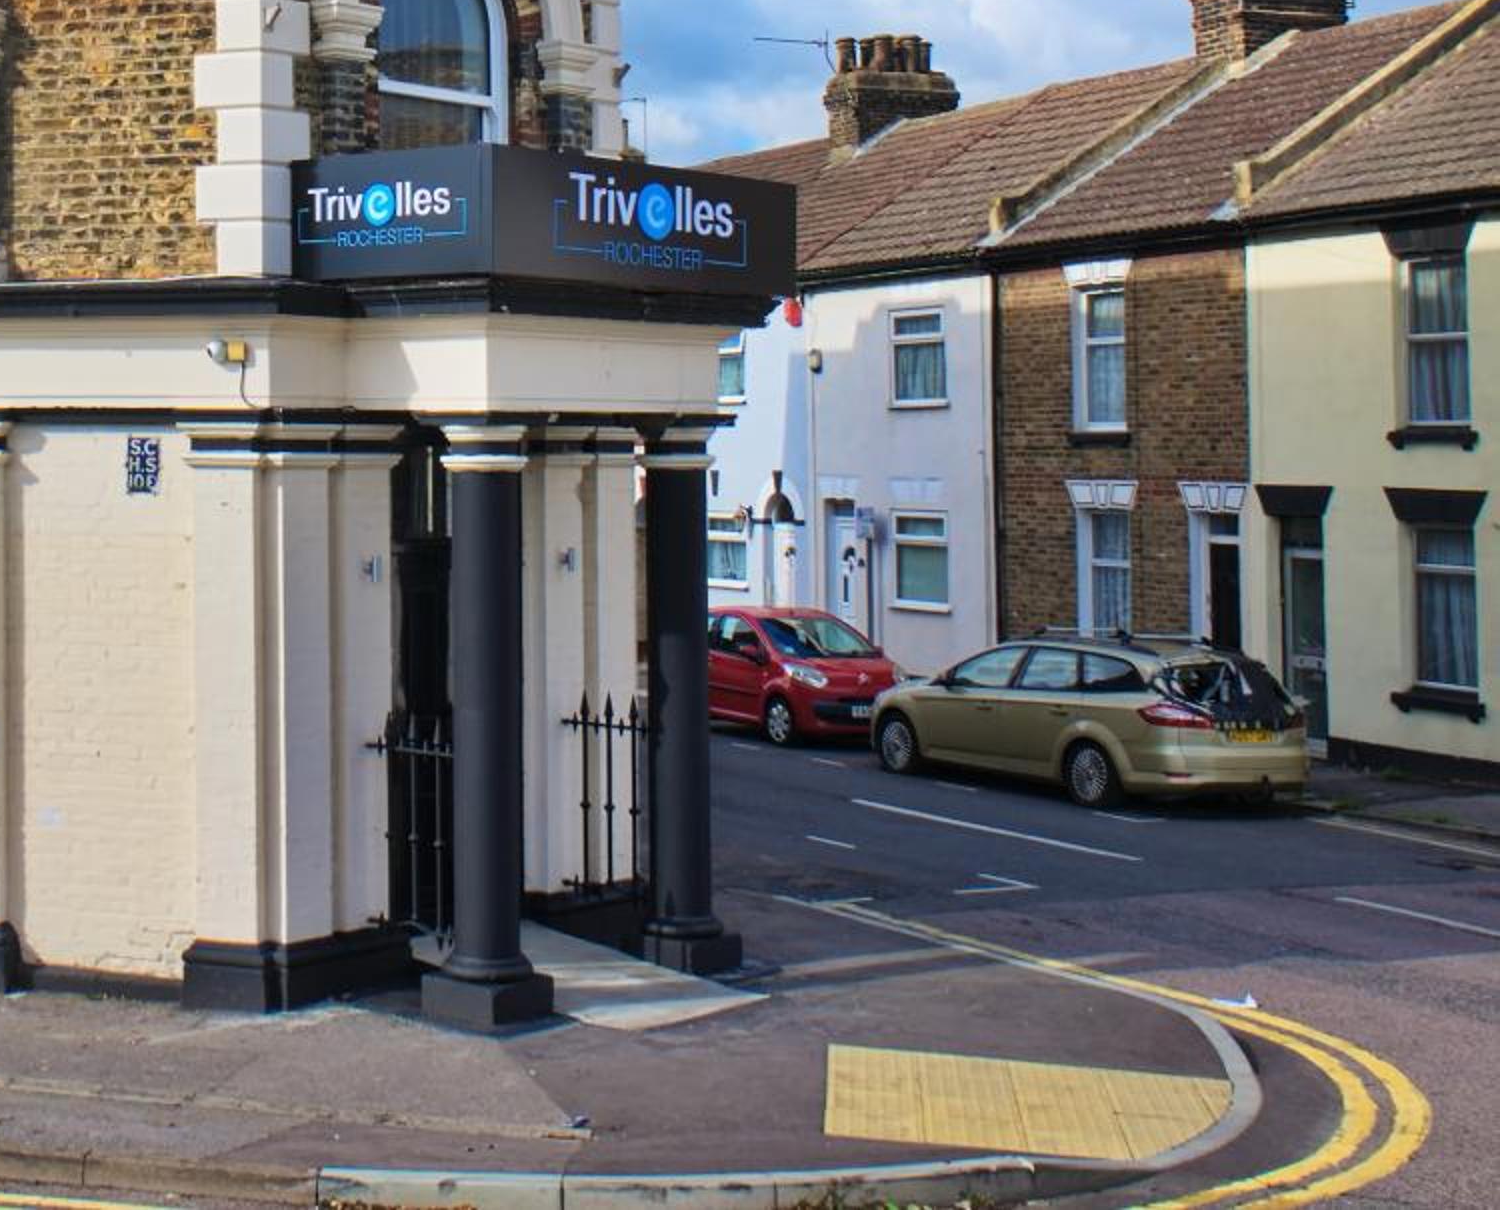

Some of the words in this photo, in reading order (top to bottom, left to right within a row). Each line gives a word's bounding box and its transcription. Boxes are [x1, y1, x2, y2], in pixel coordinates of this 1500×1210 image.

[307, 181, 451, 226] Trivelles
[569, 172, 734, 239] Trivelles
[337, 227, 424, 247] ROCHESTER
[604, 241, 702, 271] ROCHESTER
